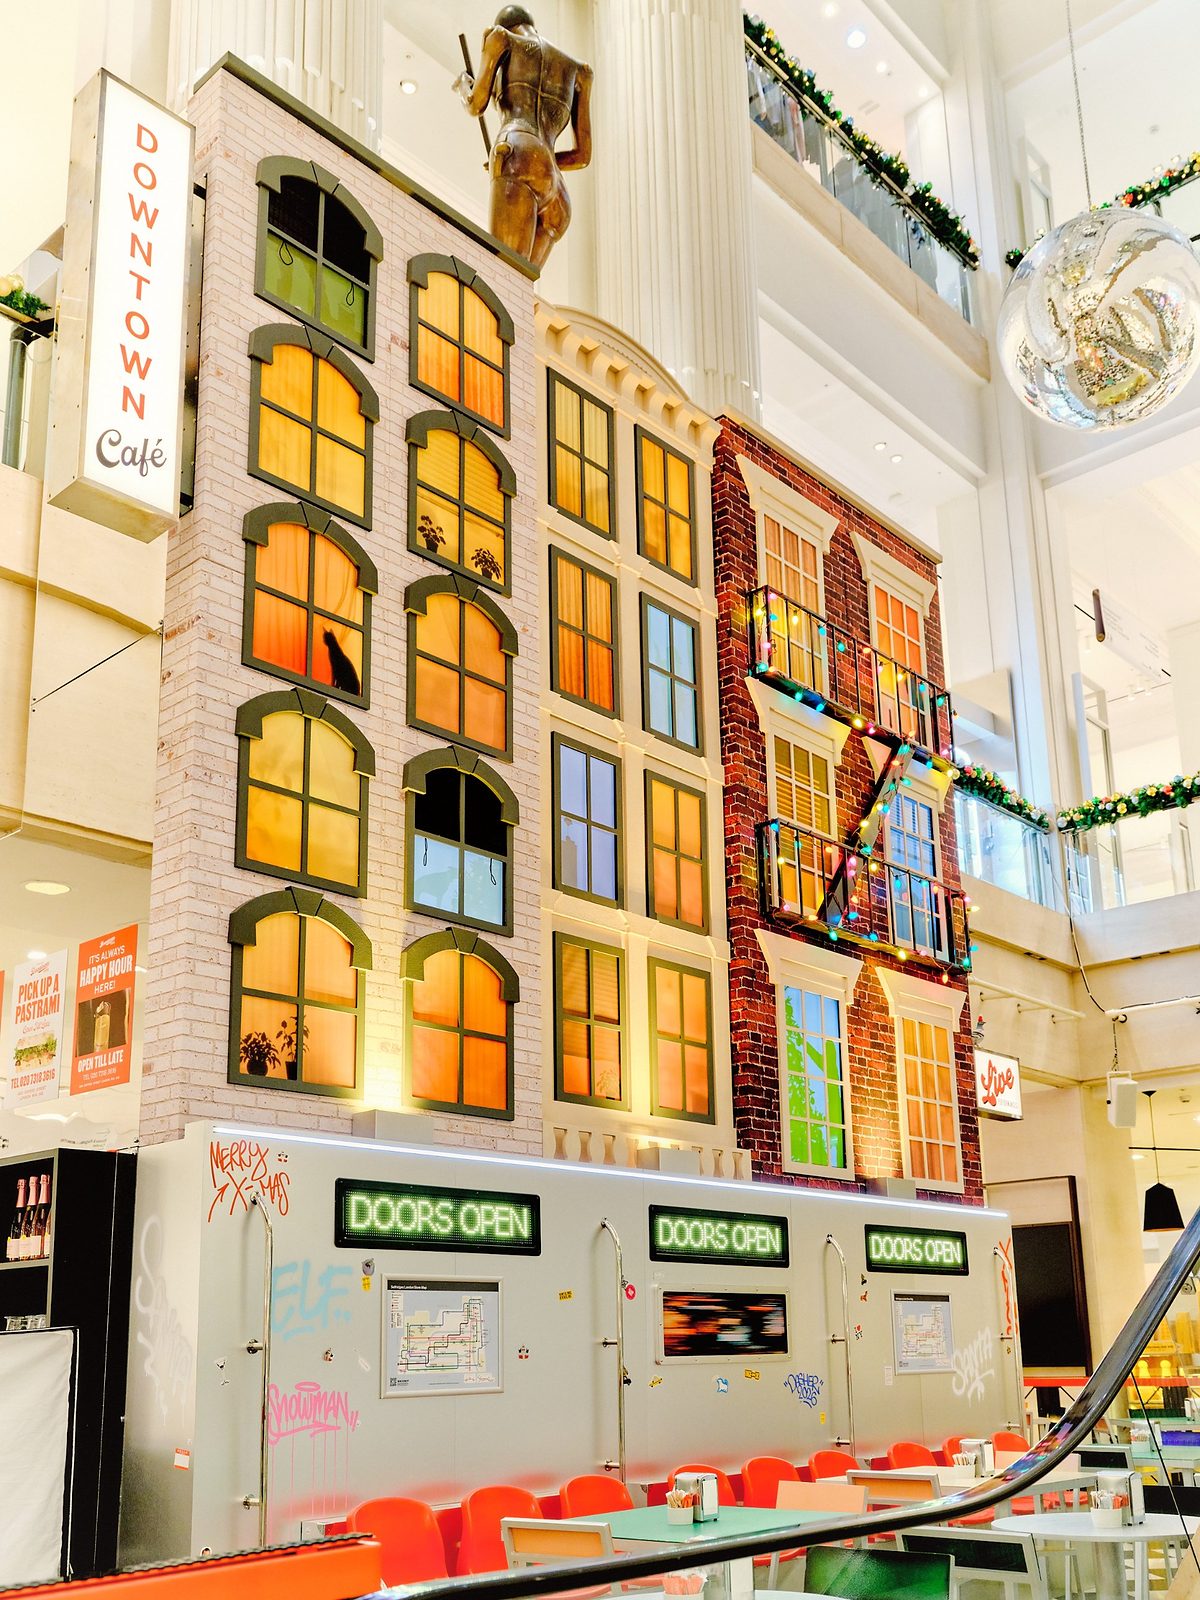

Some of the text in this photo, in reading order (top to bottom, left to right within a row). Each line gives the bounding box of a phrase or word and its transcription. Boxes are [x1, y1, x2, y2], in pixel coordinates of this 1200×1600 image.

[120, 123, 159, 420] DOWNTOWN
[96, 429, 167, 477] Café
[80, 962, 107, 988] HAPPY
[108, 954, 133, 979] HOUR
[88, 945, 125, 965] IT'S ALWAYS
[18, 973, 59, 1004] PICK UP A
[15, 993, 60, 1024] PASTRAMI
[78, 1049, 124, 1073] OPEN TILL LATE
[11, 1077, 19, 1089] TEL
[981, 1059, 1014, 1106] Live
[209, 1139, 269, 1188] MERRY
[350, 1195, 528, 1239] DOORS OPEN
[659, 1218, 780, 1253] DOORS OPEN
[871, 1235, 961, 1264] DOORS OPEN
